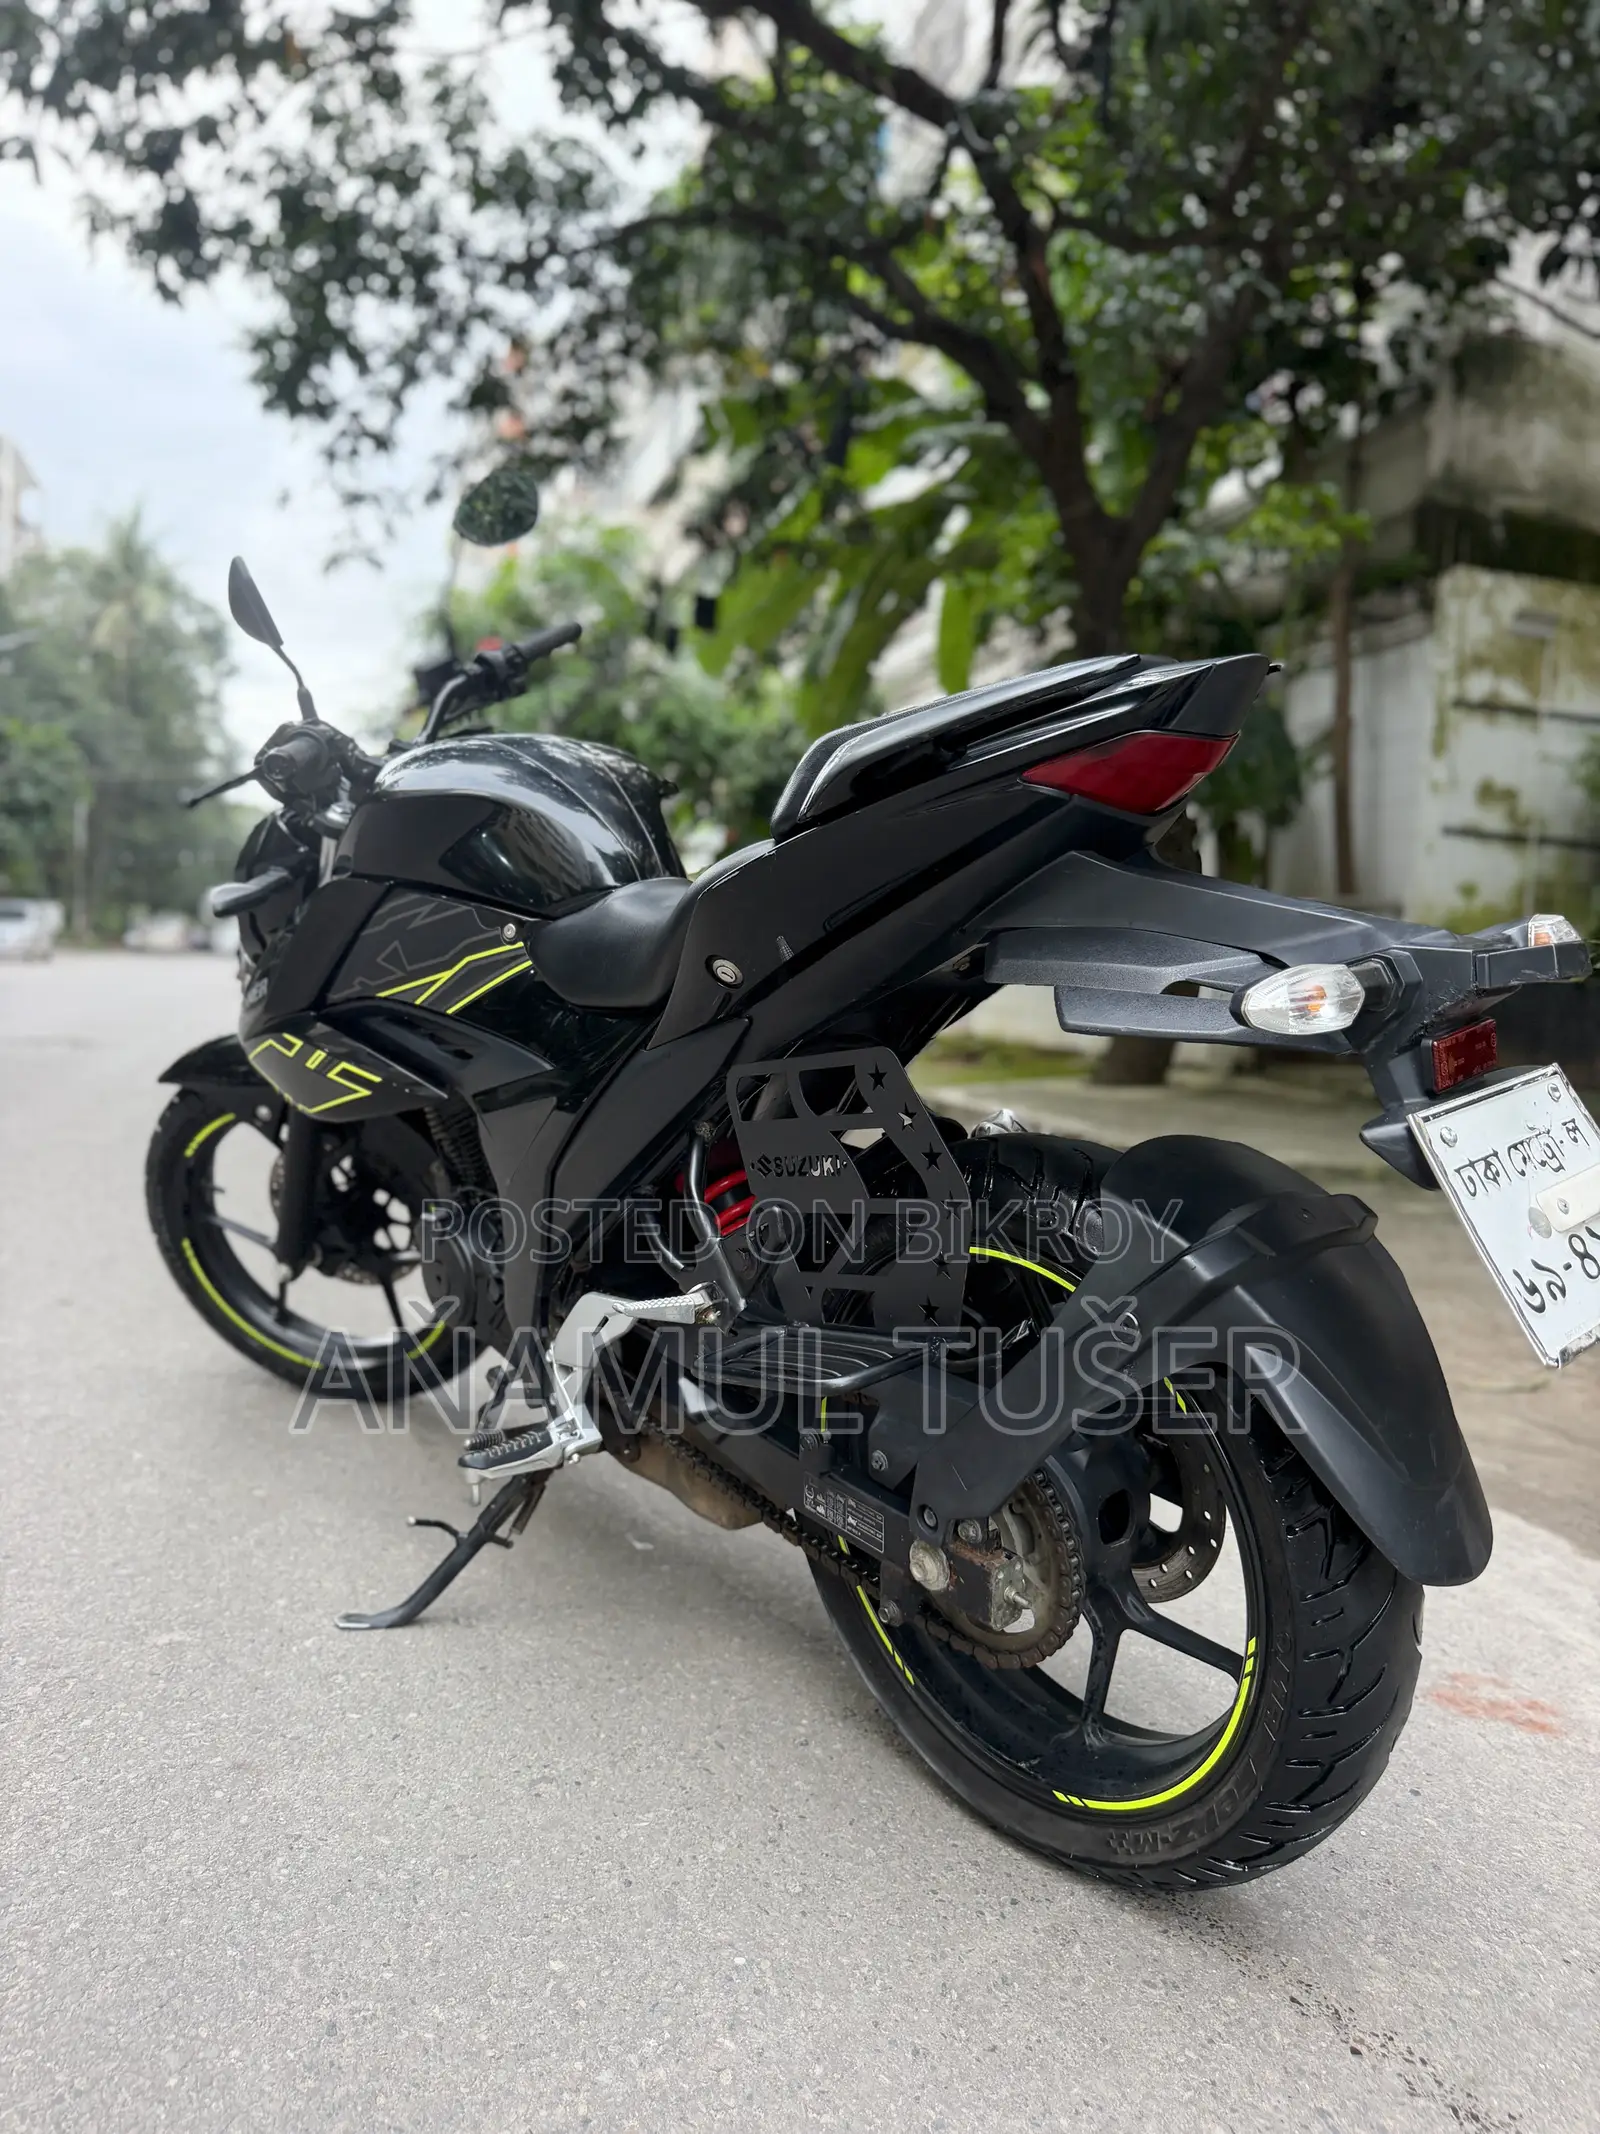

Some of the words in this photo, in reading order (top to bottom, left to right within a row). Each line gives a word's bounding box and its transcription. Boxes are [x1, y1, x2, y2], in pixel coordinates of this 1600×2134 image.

[773, 1154, 840, 1177] SUZUKI
[1454, 1148, 1512, 1197] ঢাকা
[1513, 1225, 1600, 1314] ৬৯-৪
